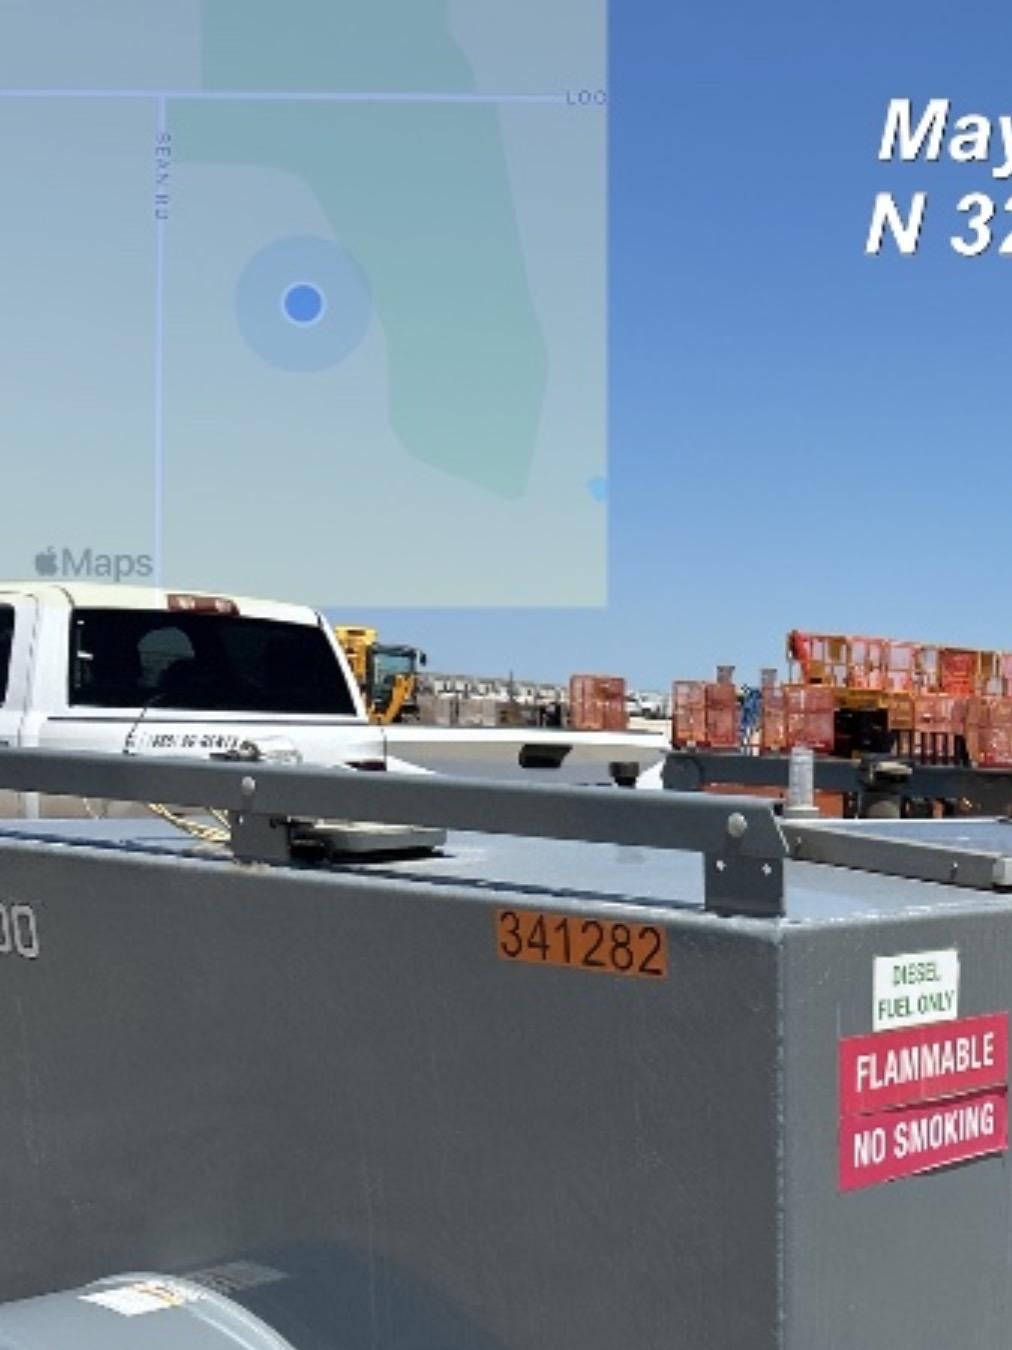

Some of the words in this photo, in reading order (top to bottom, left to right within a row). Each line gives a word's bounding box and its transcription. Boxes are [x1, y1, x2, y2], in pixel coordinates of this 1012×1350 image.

[500, 911, 664, 976] 341282
[892, 961, 940, 986] DIESEL
[878, 996, 911, 1020] FUEL
[917, 990, 954, 1015] ONLY
[855, 1032, 995, 1093] FLAMMABLE
[853, 1128, 886, 1168] NO
[893, 1103, 995, 1160] SMOKING
